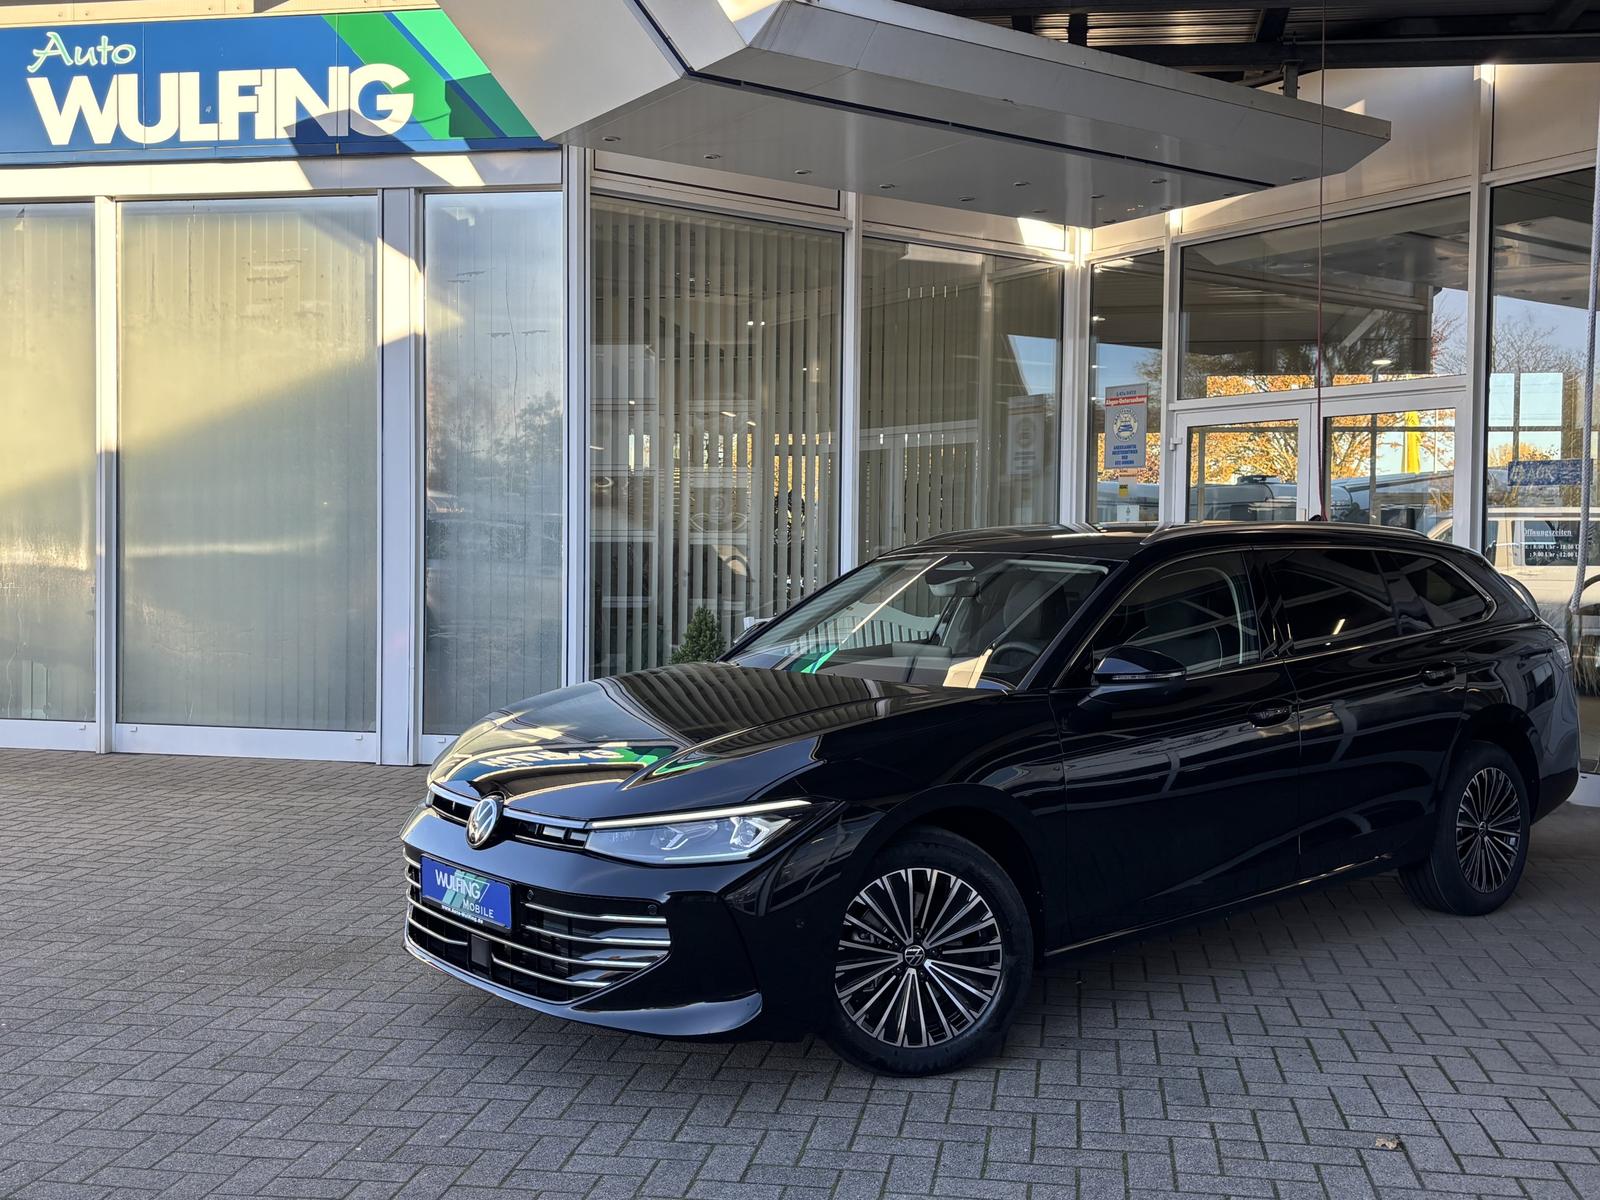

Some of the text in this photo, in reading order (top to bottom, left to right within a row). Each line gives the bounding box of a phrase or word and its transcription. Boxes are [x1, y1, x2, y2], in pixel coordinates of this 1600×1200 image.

[26, 31, 137, 73] Auto
[26, 63, 415, 146] WULFING
[434, 868, 482, 900] WULFING
[462, 898, 495, 919] MOBILE
